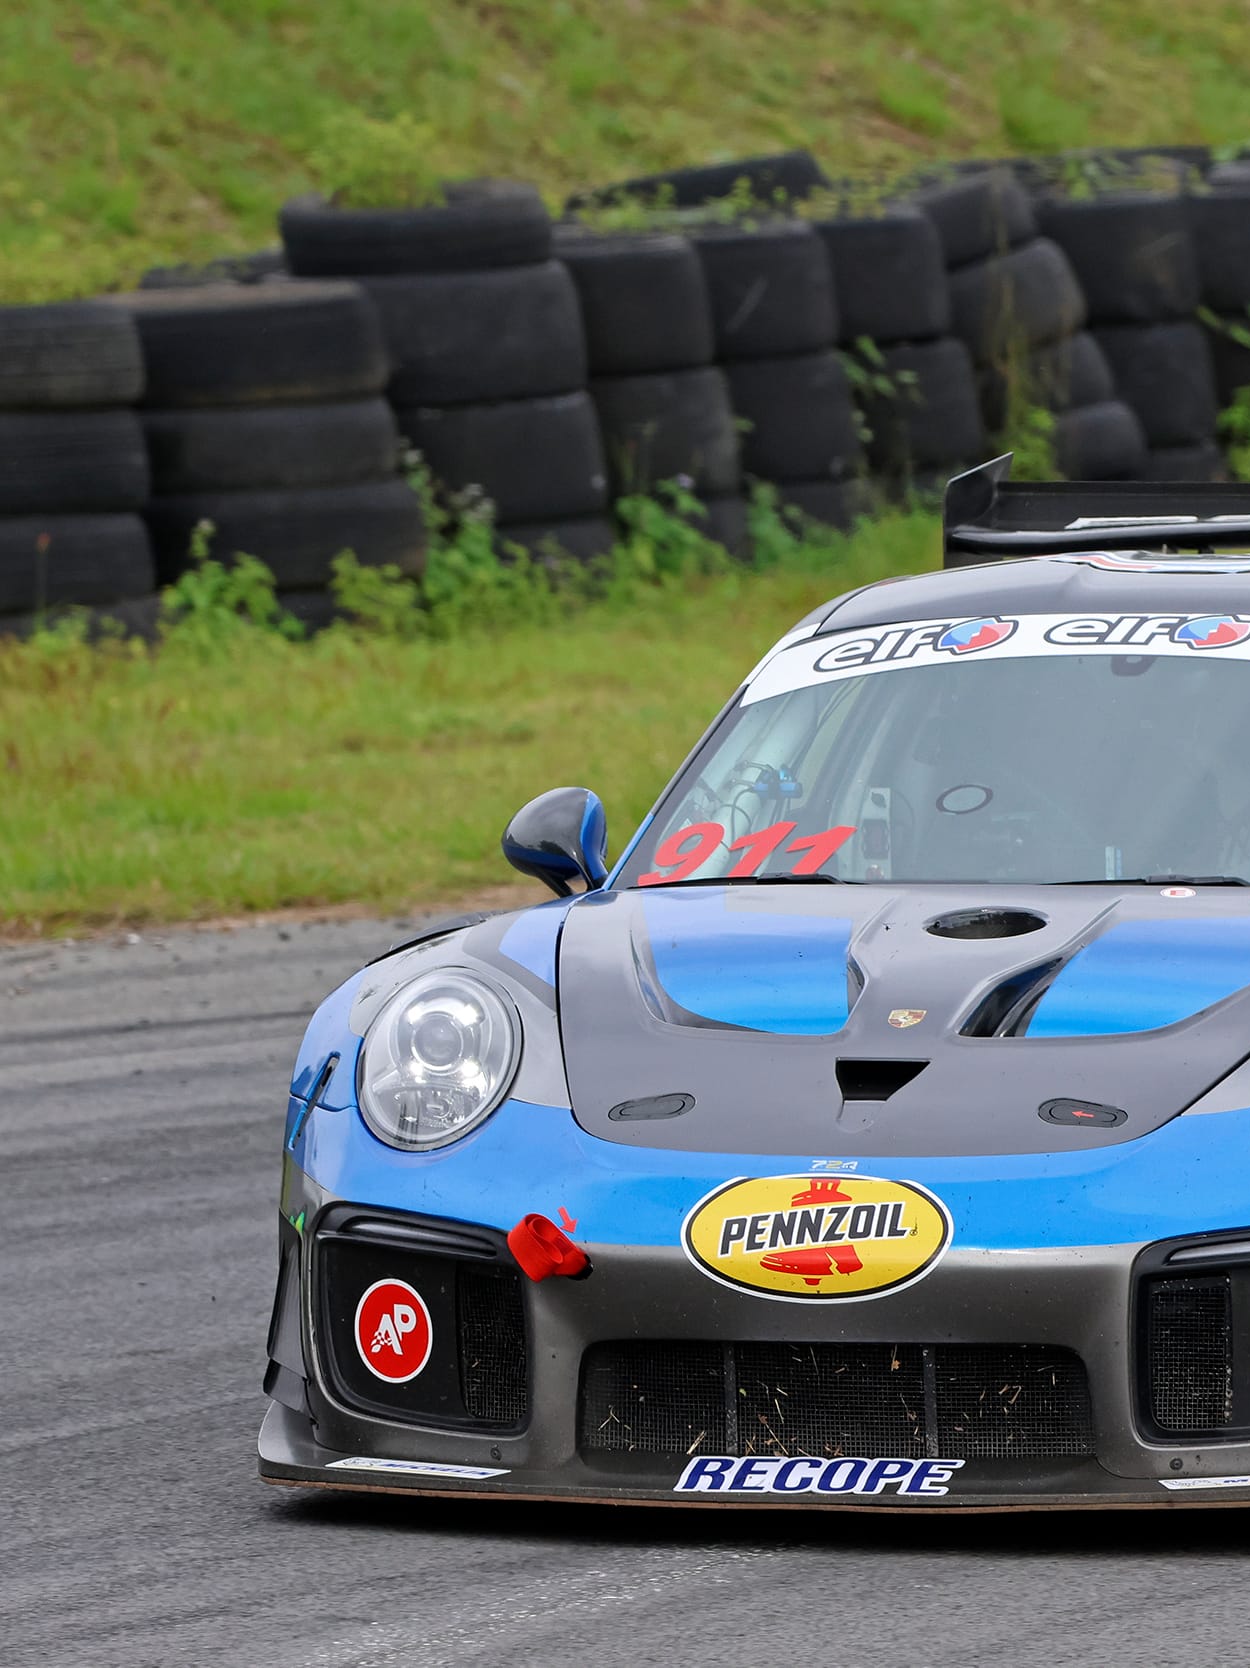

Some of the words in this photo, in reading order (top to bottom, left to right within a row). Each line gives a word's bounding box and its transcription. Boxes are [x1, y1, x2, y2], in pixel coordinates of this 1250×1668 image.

[813, 623, 951, 673] elf
[1043, 615, 1188, 646] elf
[637, 821, 858, 887] 911
[718, 1202, 907, 1257] PENNZOIL
[371, 1304, 417, 1355] AP
[674, 1456, 966, 1495] RECOPE
